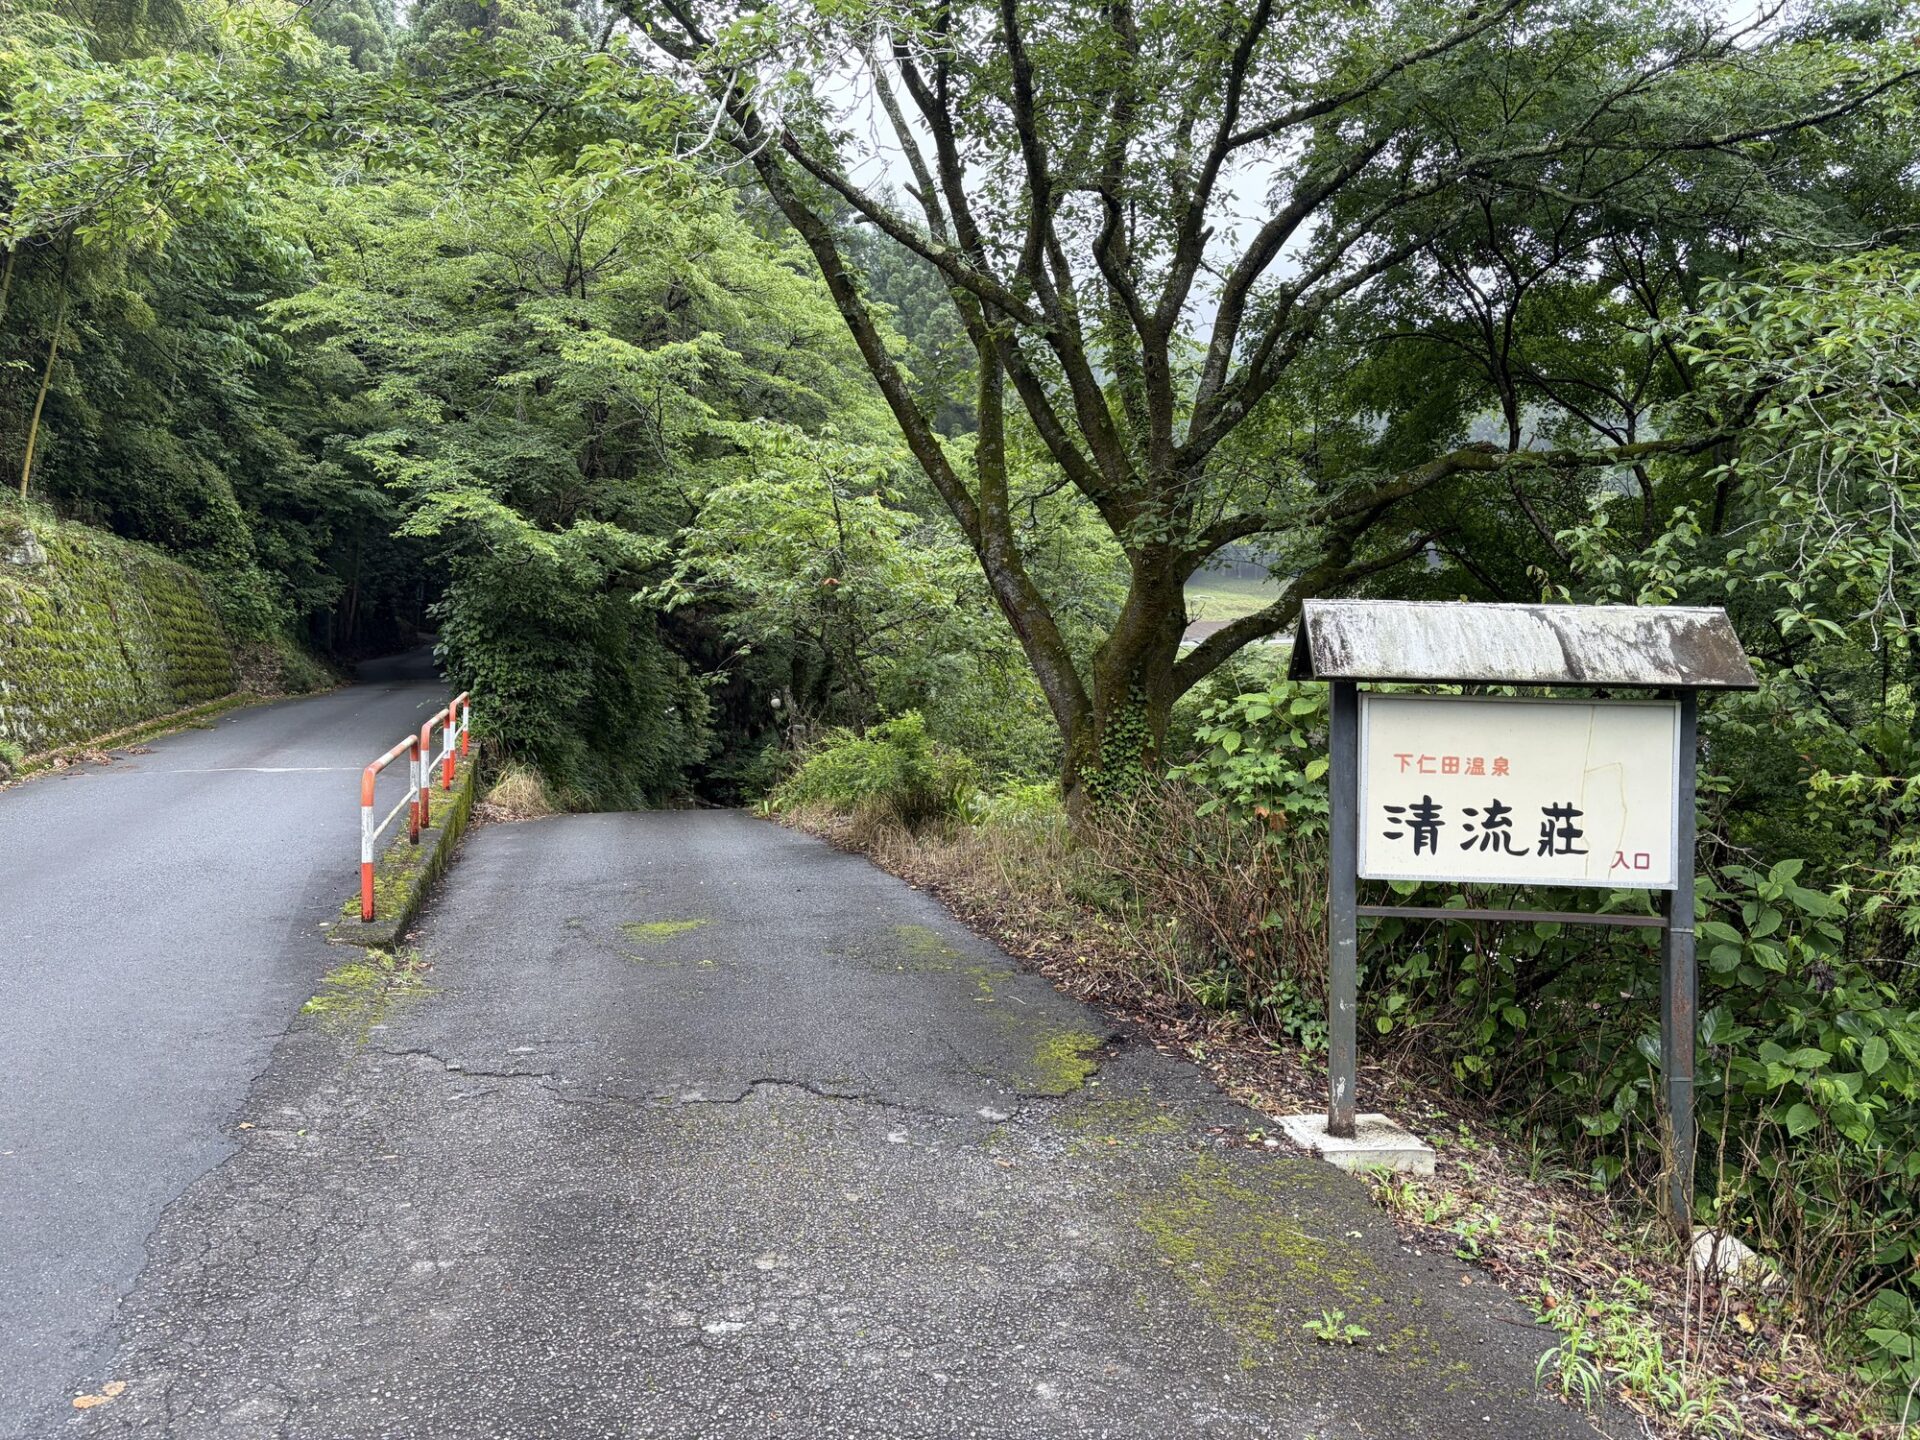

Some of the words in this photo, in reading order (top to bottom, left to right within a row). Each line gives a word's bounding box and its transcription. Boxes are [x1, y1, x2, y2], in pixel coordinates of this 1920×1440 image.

[1393, 753, 1511, 777] 下仁田温泉
[1610, 850, 1651, 870] 入口
